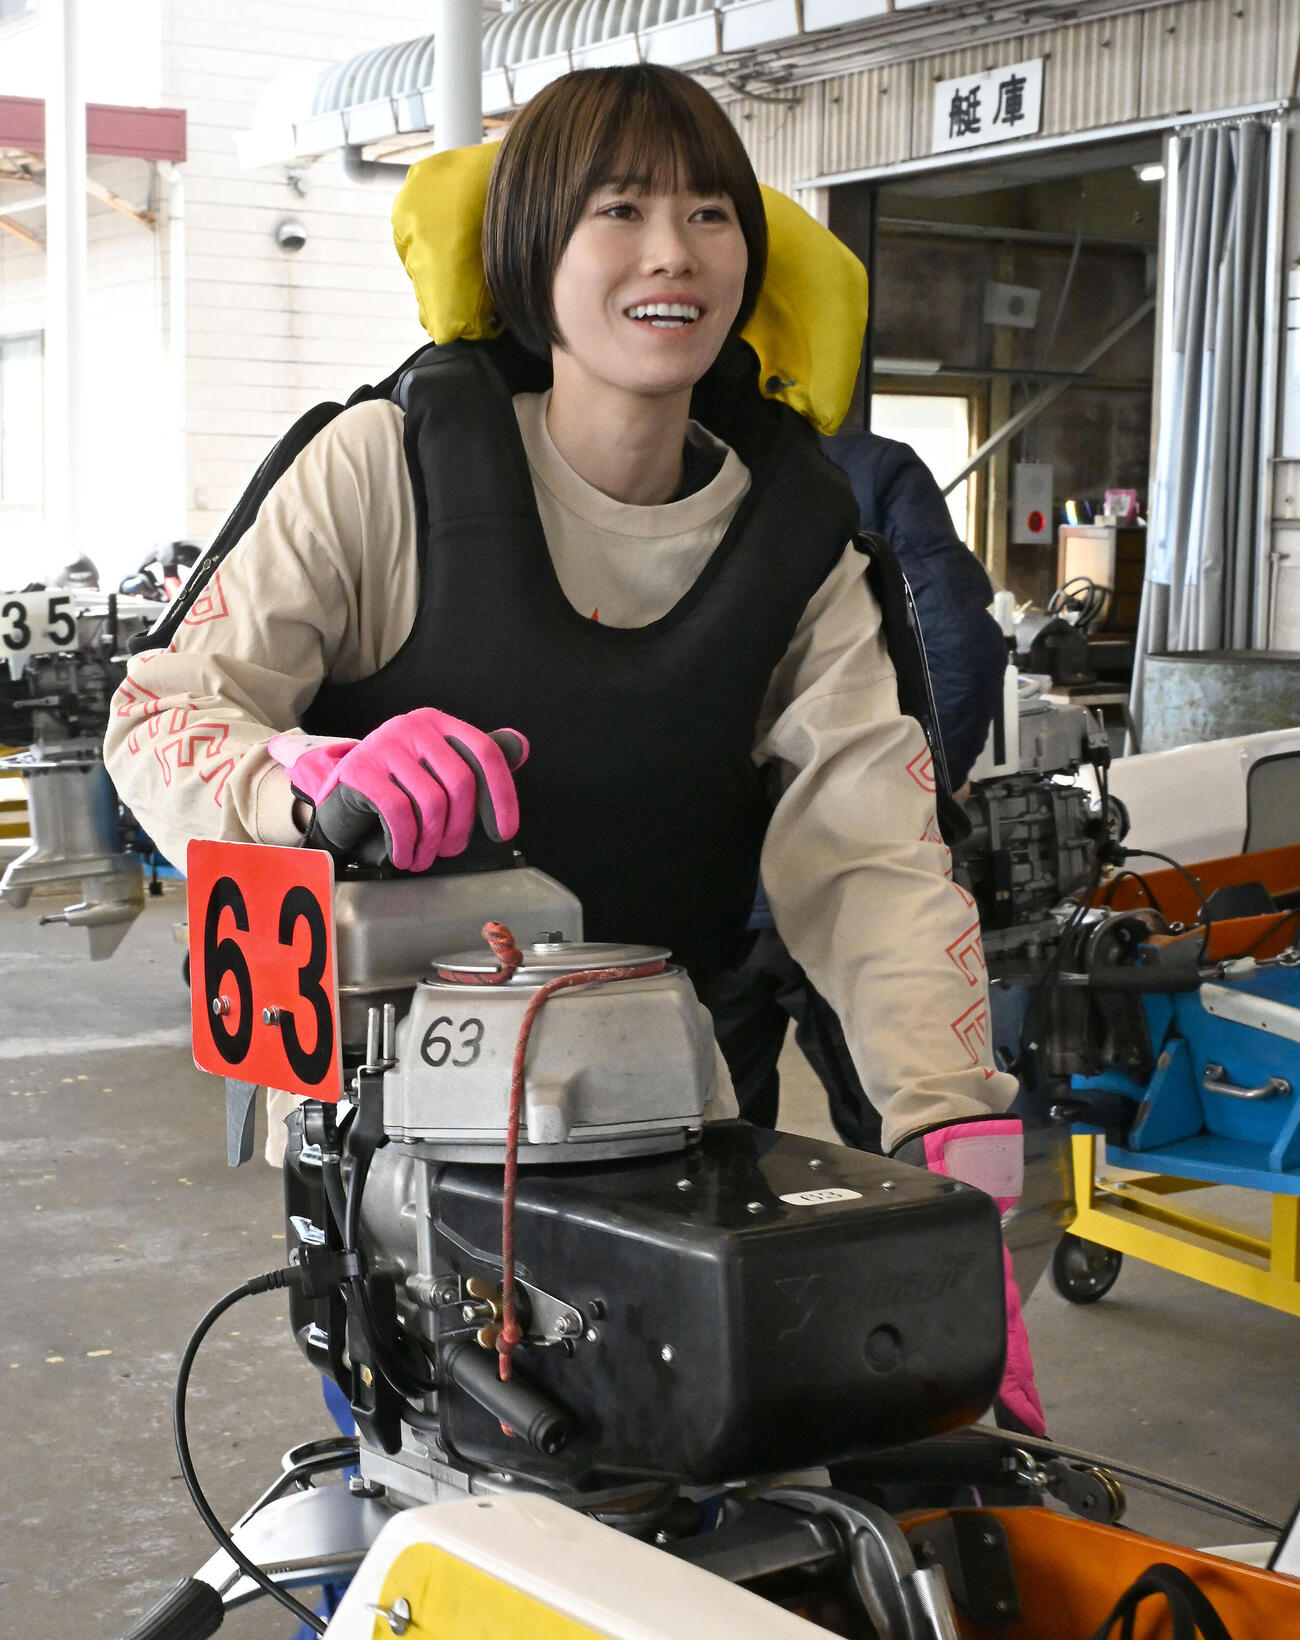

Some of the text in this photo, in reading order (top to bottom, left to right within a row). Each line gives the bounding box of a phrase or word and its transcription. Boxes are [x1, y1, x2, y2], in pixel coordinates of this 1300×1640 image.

[949, 74, 1026, 139] 艇庫
[2, 597, 76, 650] 35
[204, 877, 333, 1085] 63
[421, 1017, 485, 1068] 63
